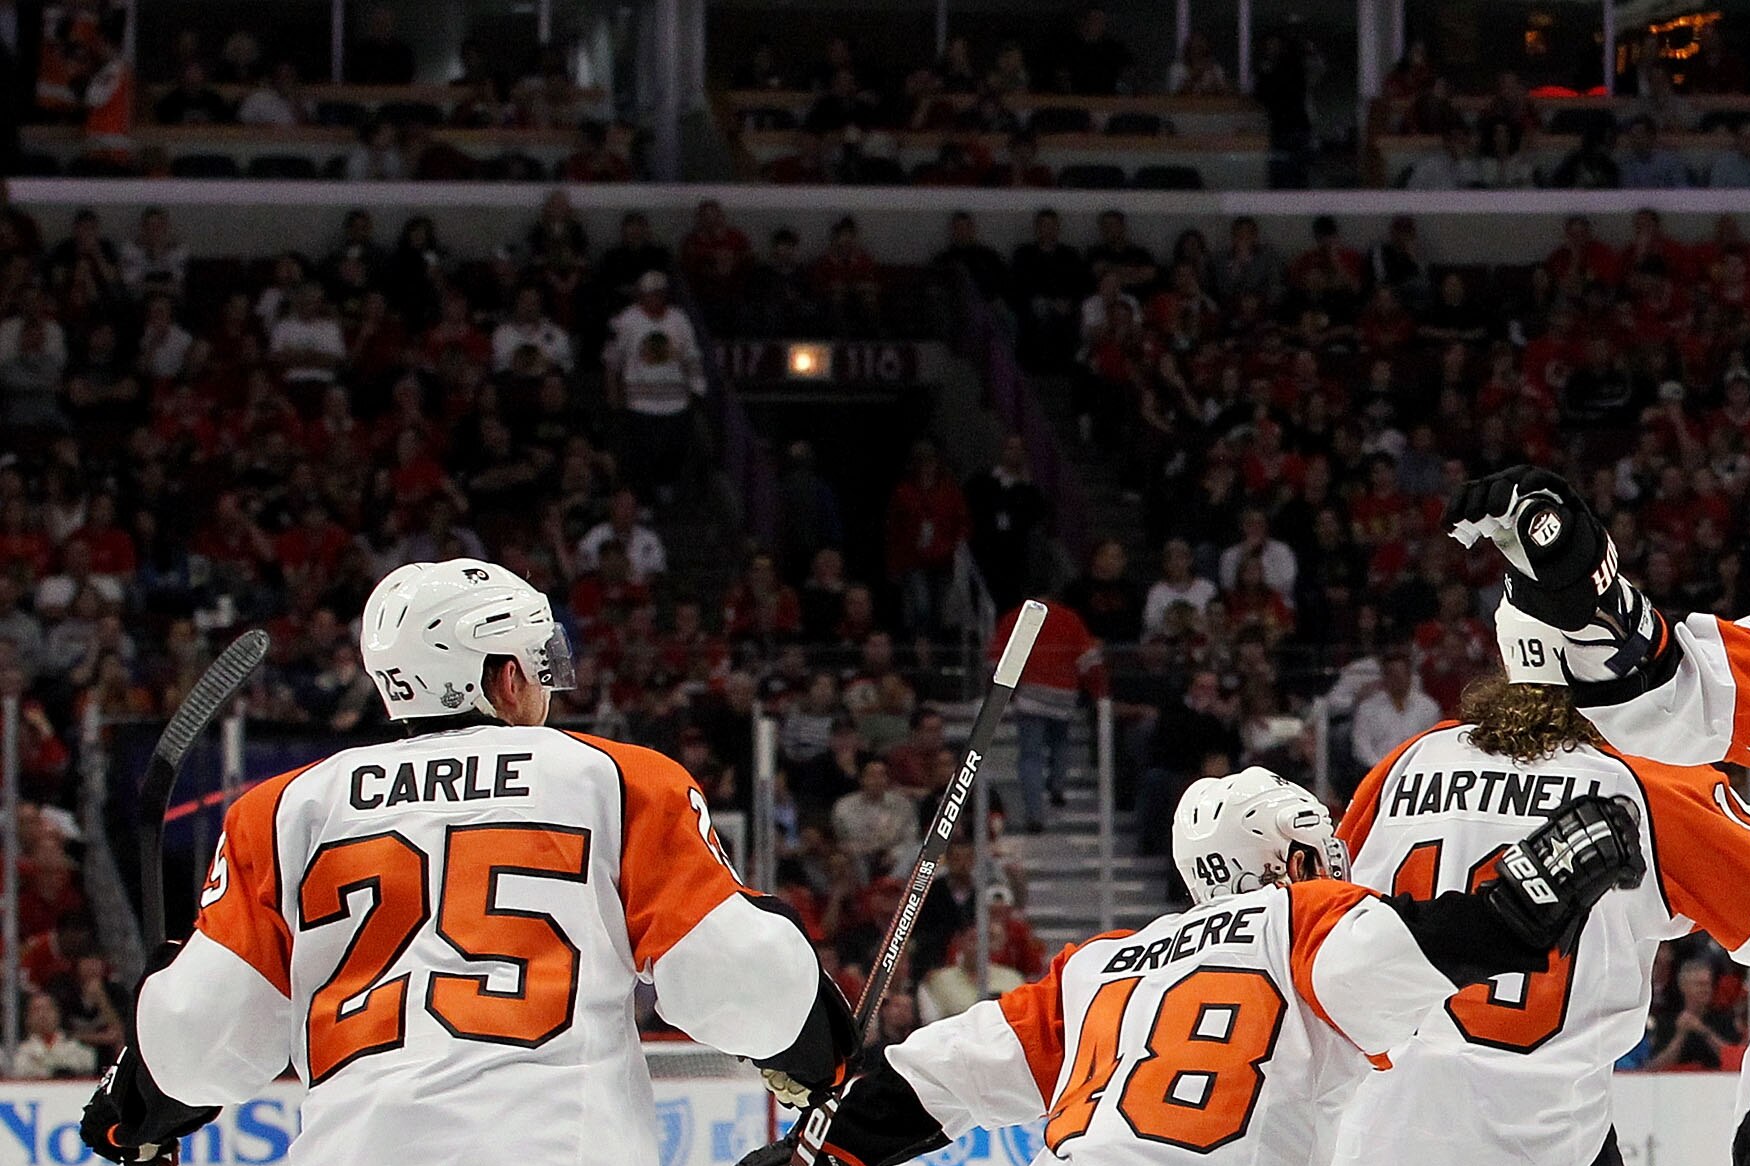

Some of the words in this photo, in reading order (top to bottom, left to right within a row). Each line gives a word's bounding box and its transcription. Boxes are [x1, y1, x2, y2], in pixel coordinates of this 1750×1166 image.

[374, 667, 415, 701] 25
[1518, 638, 1546, 668] 19
[349, 753, 533, 811] CARLE
[937, 750, 983, 841] BAUER
[1194, 852, 1231, 886] 48
[298, 821, 592, 1090] 25
[882, 893, 920, 973] SUPREME
[1101, 906, 1267, 974] BRIERE
[1043, 965, 1289, 1156] 48
